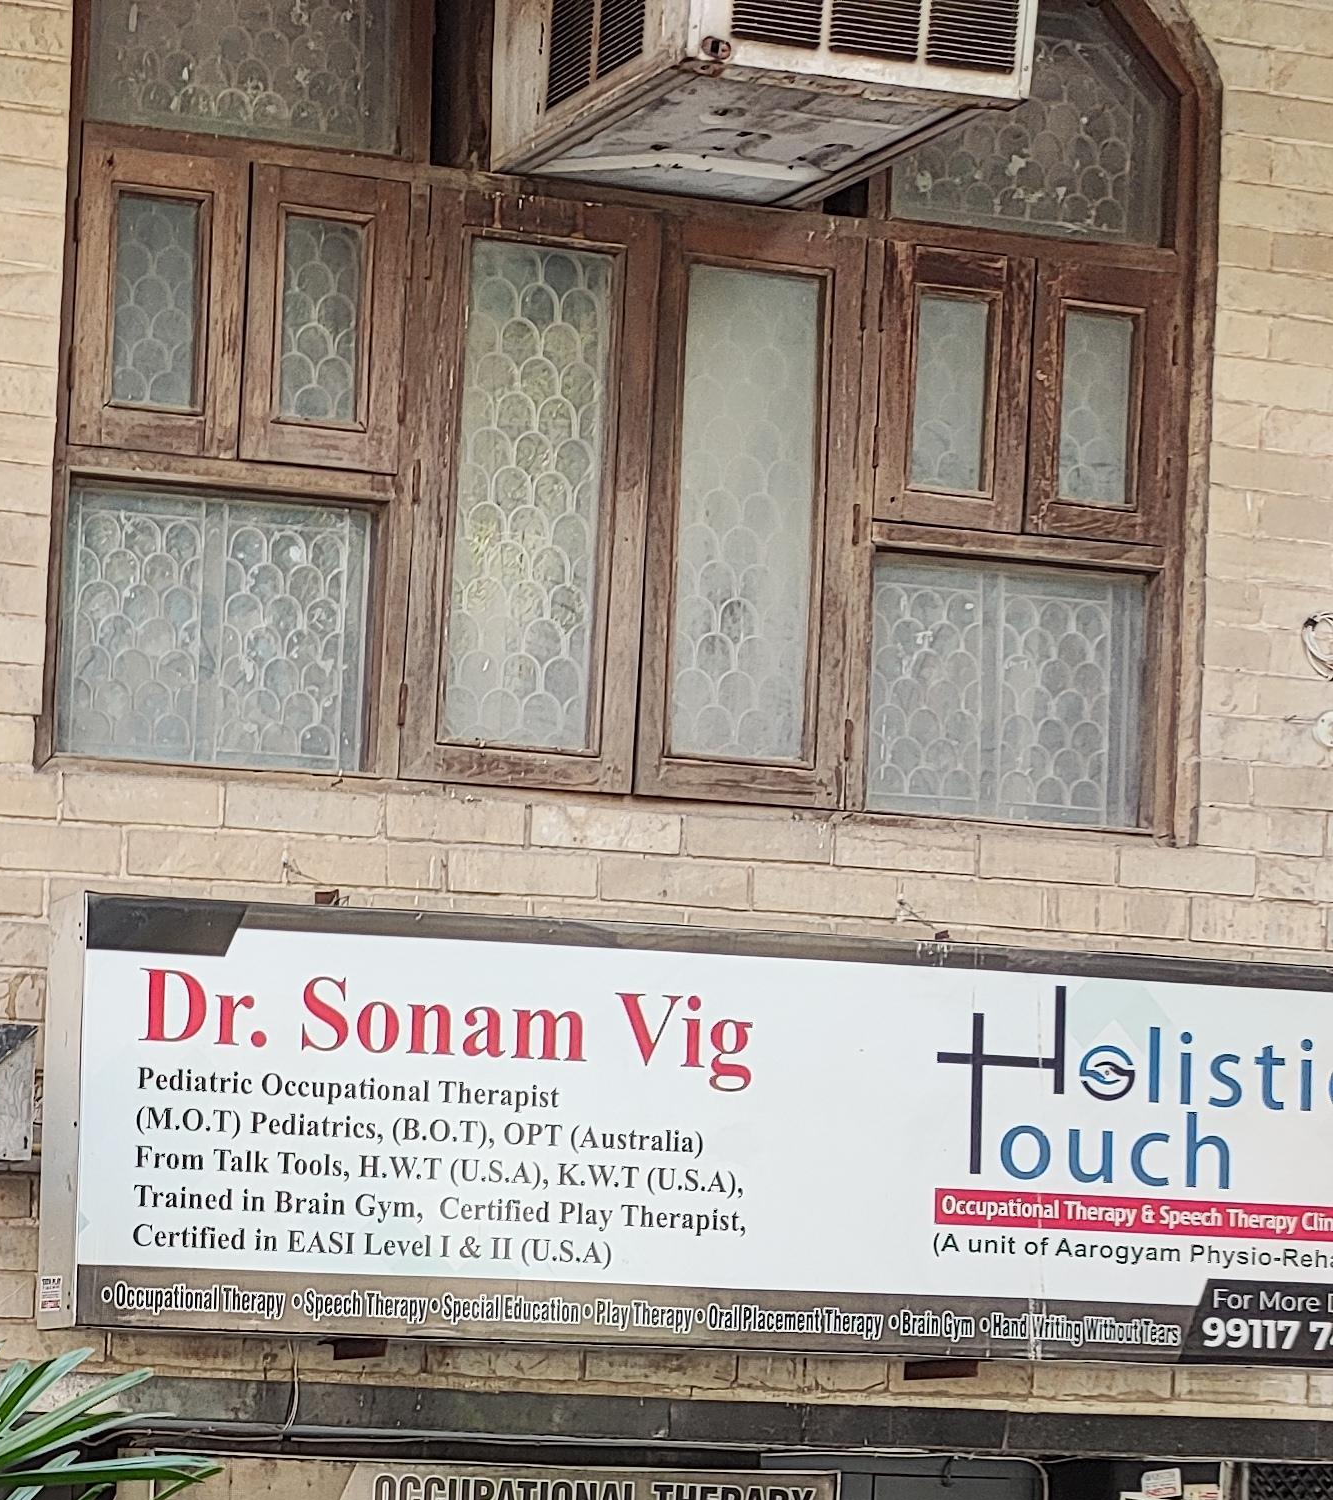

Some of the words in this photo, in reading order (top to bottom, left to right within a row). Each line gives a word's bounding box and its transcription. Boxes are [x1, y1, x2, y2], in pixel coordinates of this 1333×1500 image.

[138, 967, 268, 1049] Dr.
[301, 976, 587, 1064] Sonam
[616, 992, 754, 1093] Vig
[936, 984, 1333, 1106] Holisti
[138, 1066, 253, 1095] Pediatric
[261, 1072, 429, 1105] Occupational
[438, 1080, 559, 1113] Therapist
[136, 1105, 241, 1139] (M.O.T)
[250, 1111, 383, 1144] Pediatrics,
[392, 1117, 495, 1149] (B.O.T),
[504, 1122, 563, 1147] OPT
[570, 1125, 703, 1159] (Australia)
[963, 1098, 1231, 1180] Touch
[135, 1145, 204, 1171] From
[213, 1148, 269, 1173] Talk
[277, 1151, 350, 1182] Tools,
[358, 1154, 442, 1180] H.W.T
[450, 1159, 549, 1190] (U.S.A),
[557, 1163, 640, 1189] K.W.T
[647, 1167, 743, 1199] (U.S.A),
[133, 1184, 232, 1211] Trained
[242, 1188, 265, 1212] in
[275, 1190, 345, 1216] Brain
[355, 1193, 423, 1224] Gym,
[440, 1197, 550, 1223] Certified
[559, 1201, 613, 1232] Play
[621, 1204, 746, 1237] Therapist,
[942, 1195, 1060, 1227] Occupational
[1063, 1200, 1138, 1227] Therapy
[1141, 1204, 1156, 1224] &
[1159, 1205, 1223, 1230] Speech
[1225, 1208, 1298, 1235] Therapy
[132, 1223, 246, 1250] Certified
[254, 1228, 278, 1252] in
[287, 1230, 355, 1255] EASI
[364, 1232, 431, 1257] Level
[440, 1235, 449, 1258] I
[459, 1236, 481, 1259] &
[491, 1237, 511, 1260] II
[521, 1238, 611, 1270] (U.S.A)
[933, 1233, 960, 1257] (A
[968, 1235, 1016, 1255] unit
[1024, 1237, 1049, 1256] of
[1055, 1237, 1180, 1265] Aarogyam
[114, 1282, 221, 1315] Occupational
[222, 1286, 286, 1321] Therapy
[303, 1289, 363, 1322] Speech
[364, 1291, 429, 1325] Therapy
[440, 1294, 502, 1327] Special
[502, 1296, 581, 1325] Education
[1213, 1288, 1254, 1310] For
[1259, 1290, 1321, 1313] More
[1202, 1317, 1301, 1350] 99117
[1309, 1321, 1333, 1351] 7
